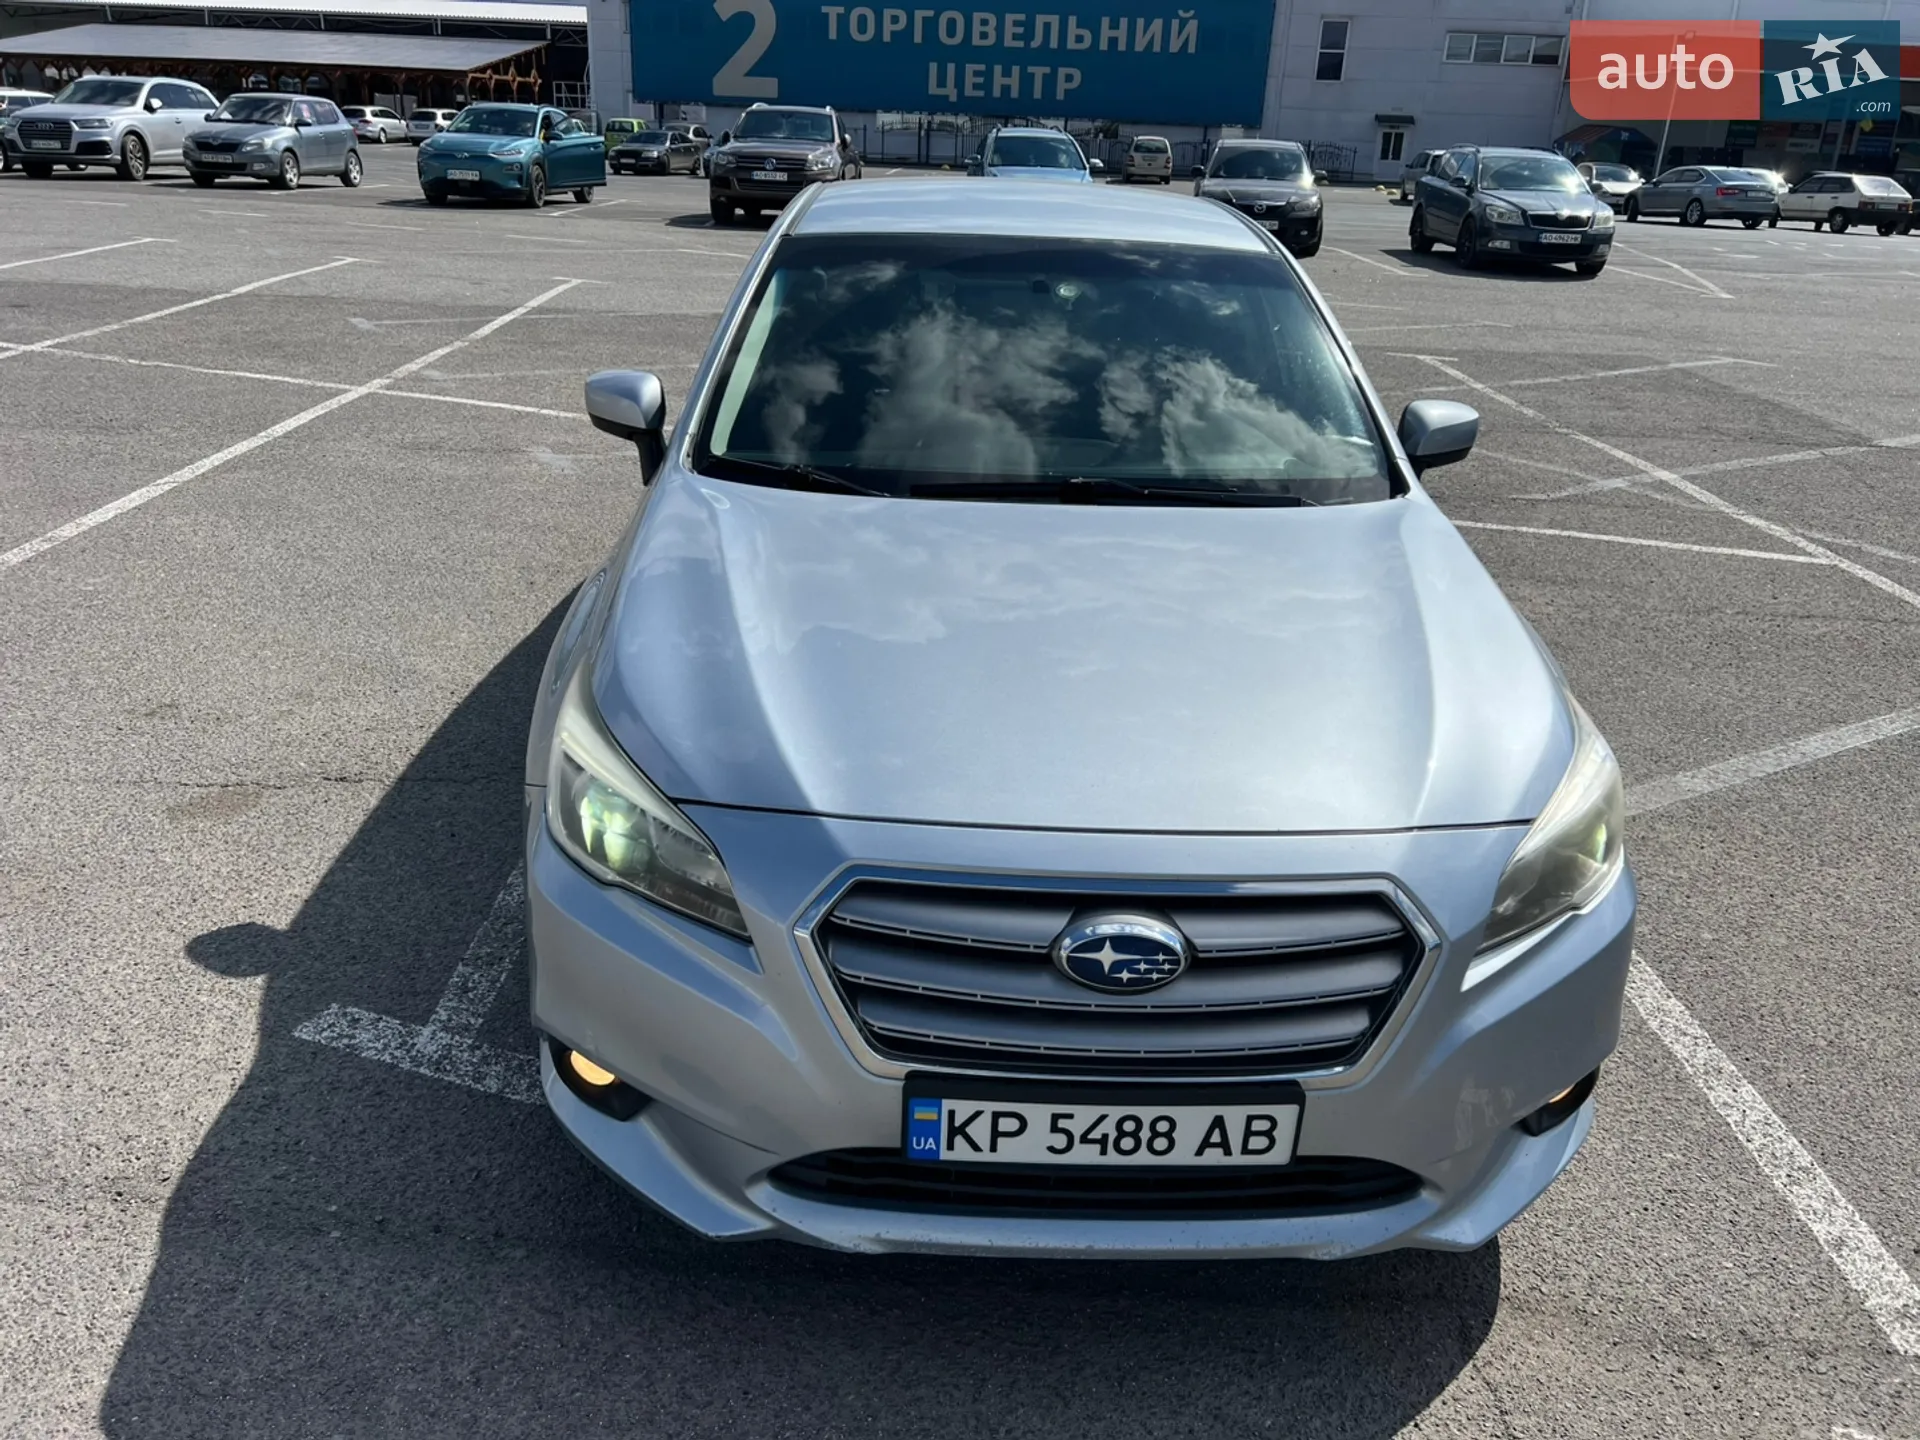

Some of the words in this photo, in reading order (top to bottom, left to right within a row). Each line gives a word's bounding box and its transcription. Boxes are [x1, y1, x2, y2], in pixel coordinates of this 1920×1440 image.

[713, 0, 778, 98] 2
[821, 6, 1199, 54] ТОРГОВЕЛЬНИЙ
[928, 62, 1082, 102] ЦЕНТР
[912, 1136, 936, 1151] UA
[946, 1109, 1028, 1153] KP
[1046, 1112, 1177, 1156] 5488
[1194, 1114, 1278, 1157] AB
